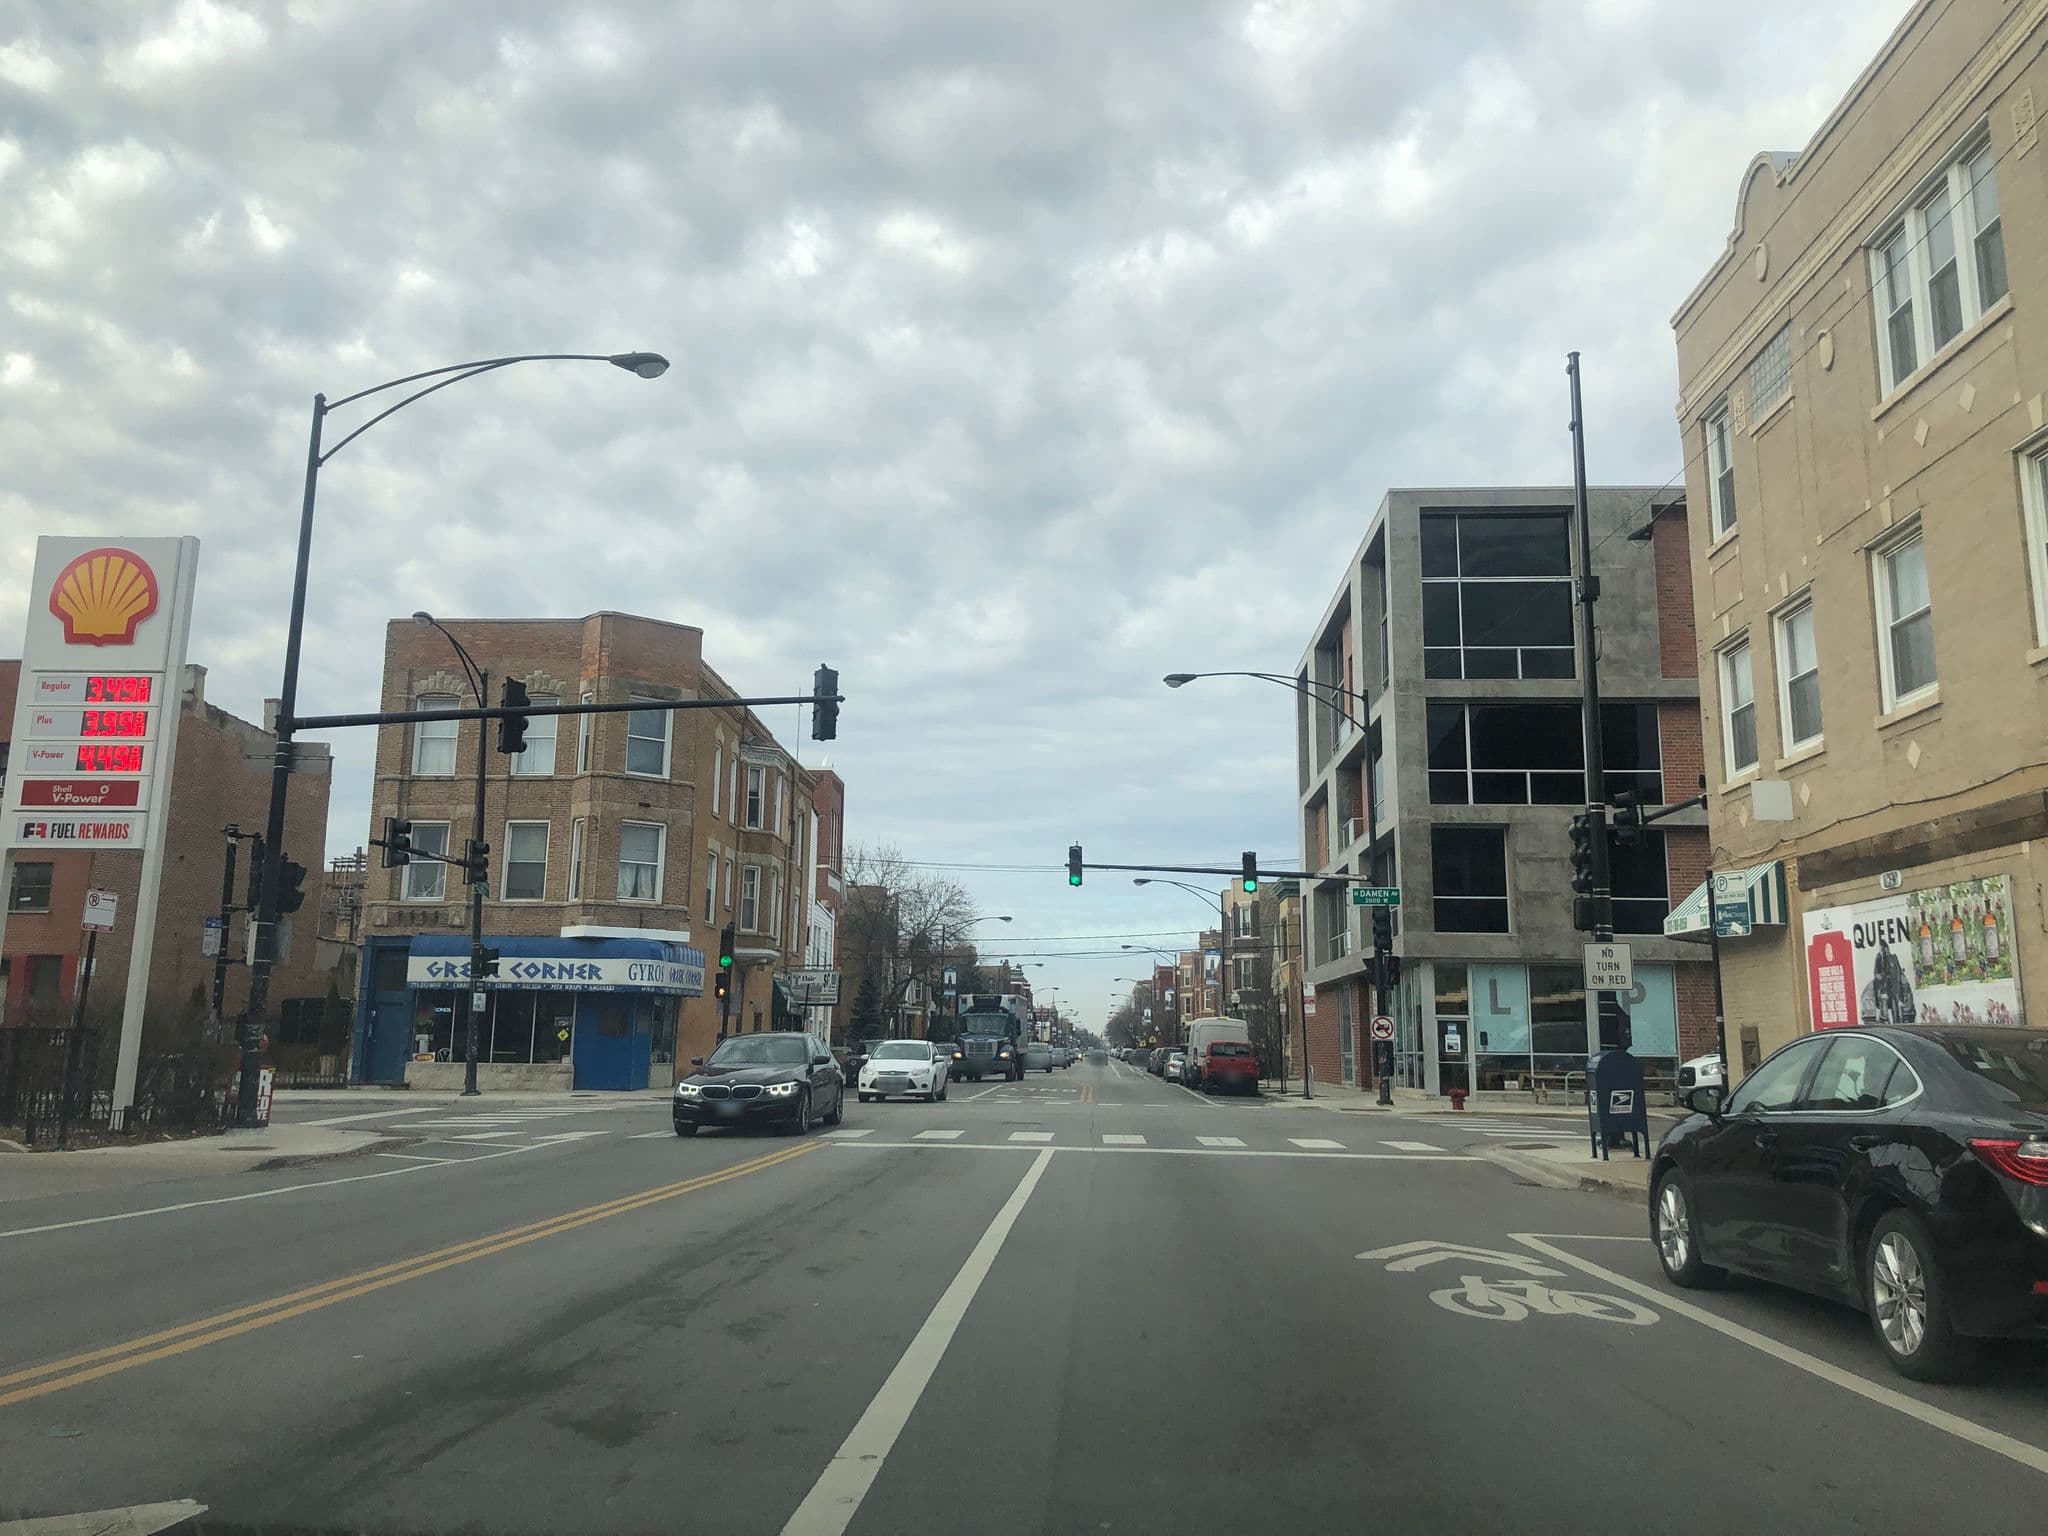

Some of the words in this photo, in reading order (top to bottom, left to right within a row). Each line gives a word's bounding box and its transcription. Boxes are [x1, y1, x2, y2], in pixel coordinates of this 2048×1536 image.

[41, 681, 71, 691] Regular
[36, 715, 53, 724] Plus
[32, 750, 64, 759] V-Power
[53, 793, 104, 803] V-Power
[50, 823, 75, 839] FUEL
[78, 822, 129, 839] REWARDS
[1853, 915, 1912, 949] QUEEN
[1601, 948, 1614, 958] NO
[509, 961, 603, 980] CORNER
[1596, 962, 1620, 971] TURN
[628, 963, 664, 983] GYROS
[1592, 975, 1604, 984] ON
[1609, 975, 1627, 984] RED
